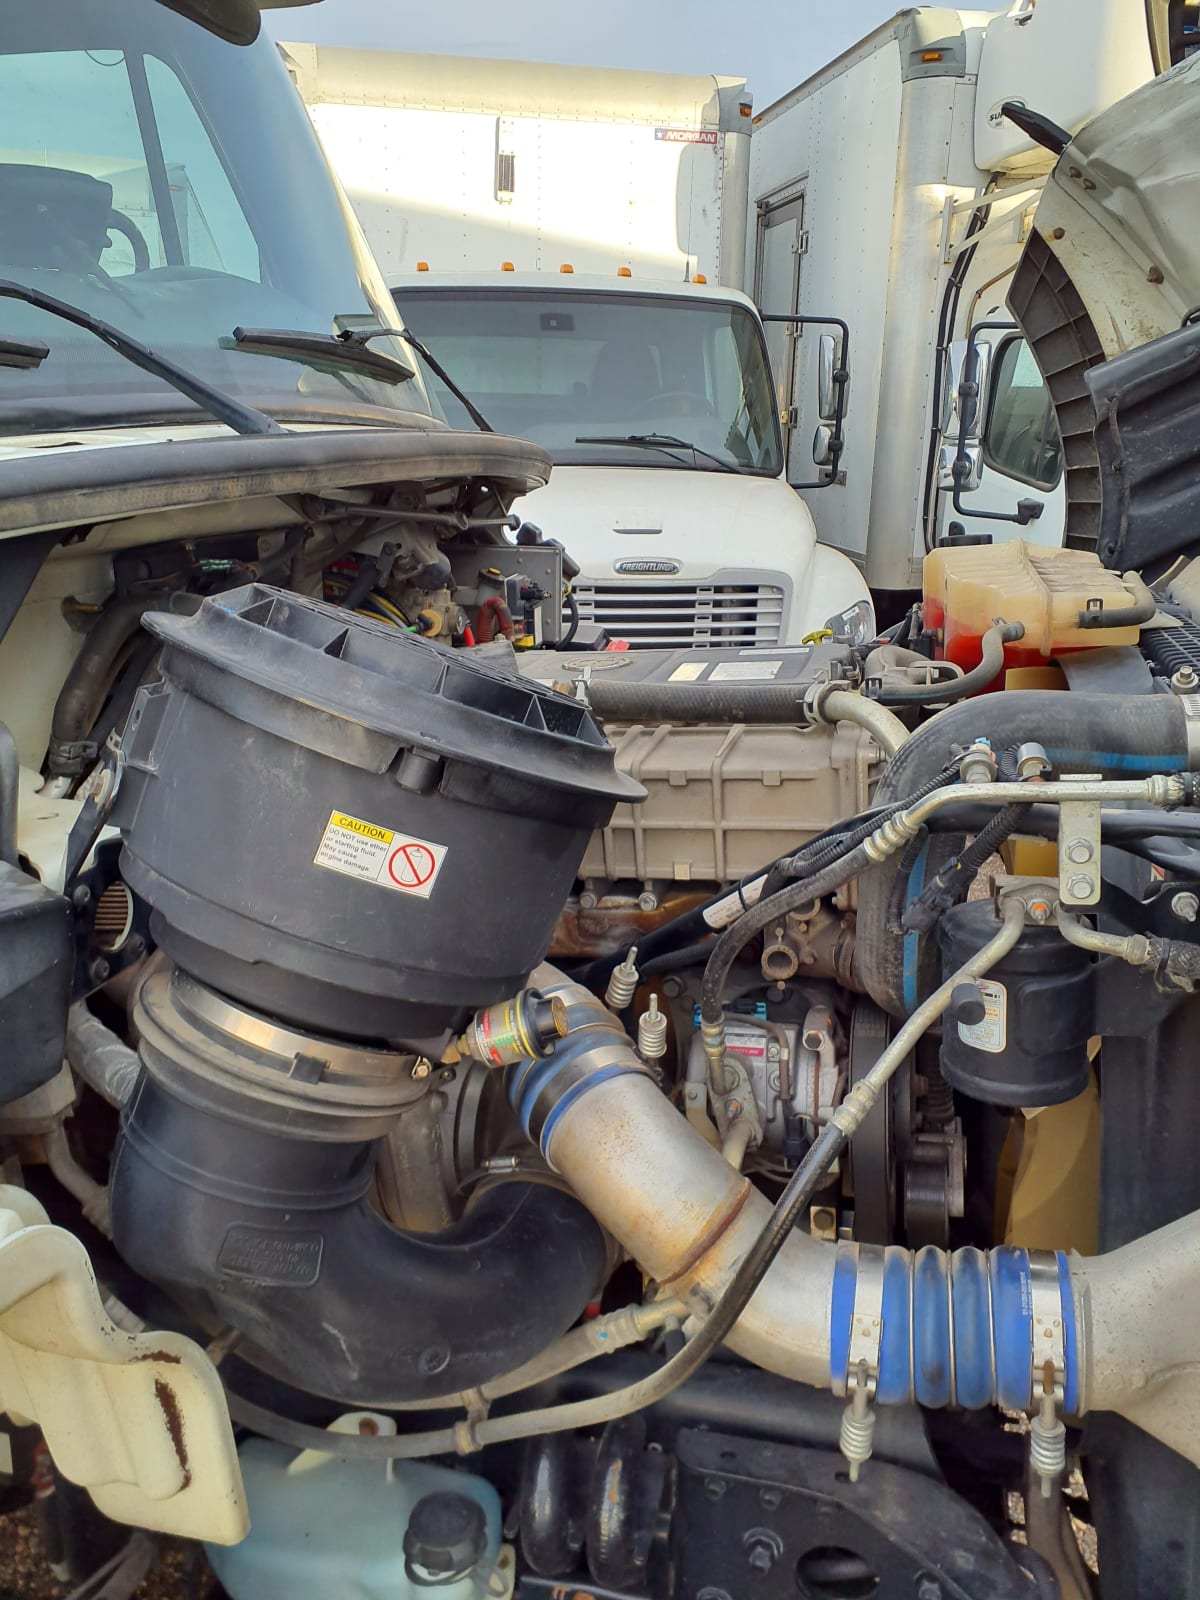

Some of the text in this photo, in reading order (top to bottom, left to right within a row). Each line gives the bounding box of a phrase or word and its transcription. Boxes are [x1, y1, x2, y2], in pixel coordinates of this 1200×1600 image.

[666, 131, 716, 143] MORGAN
[622, 562, 674, 571] FREIGHTLINER
[339, 817, 386, 839] CAUTION
[329, 827, 339, 835] DO
[341, 832, 355, 841] NOT
[369, 843, 387, 852] ether
[335, 839, 359, 853] starting
[320, 851, 342, 863] engine
[324, 843, 357, 859] May cause
